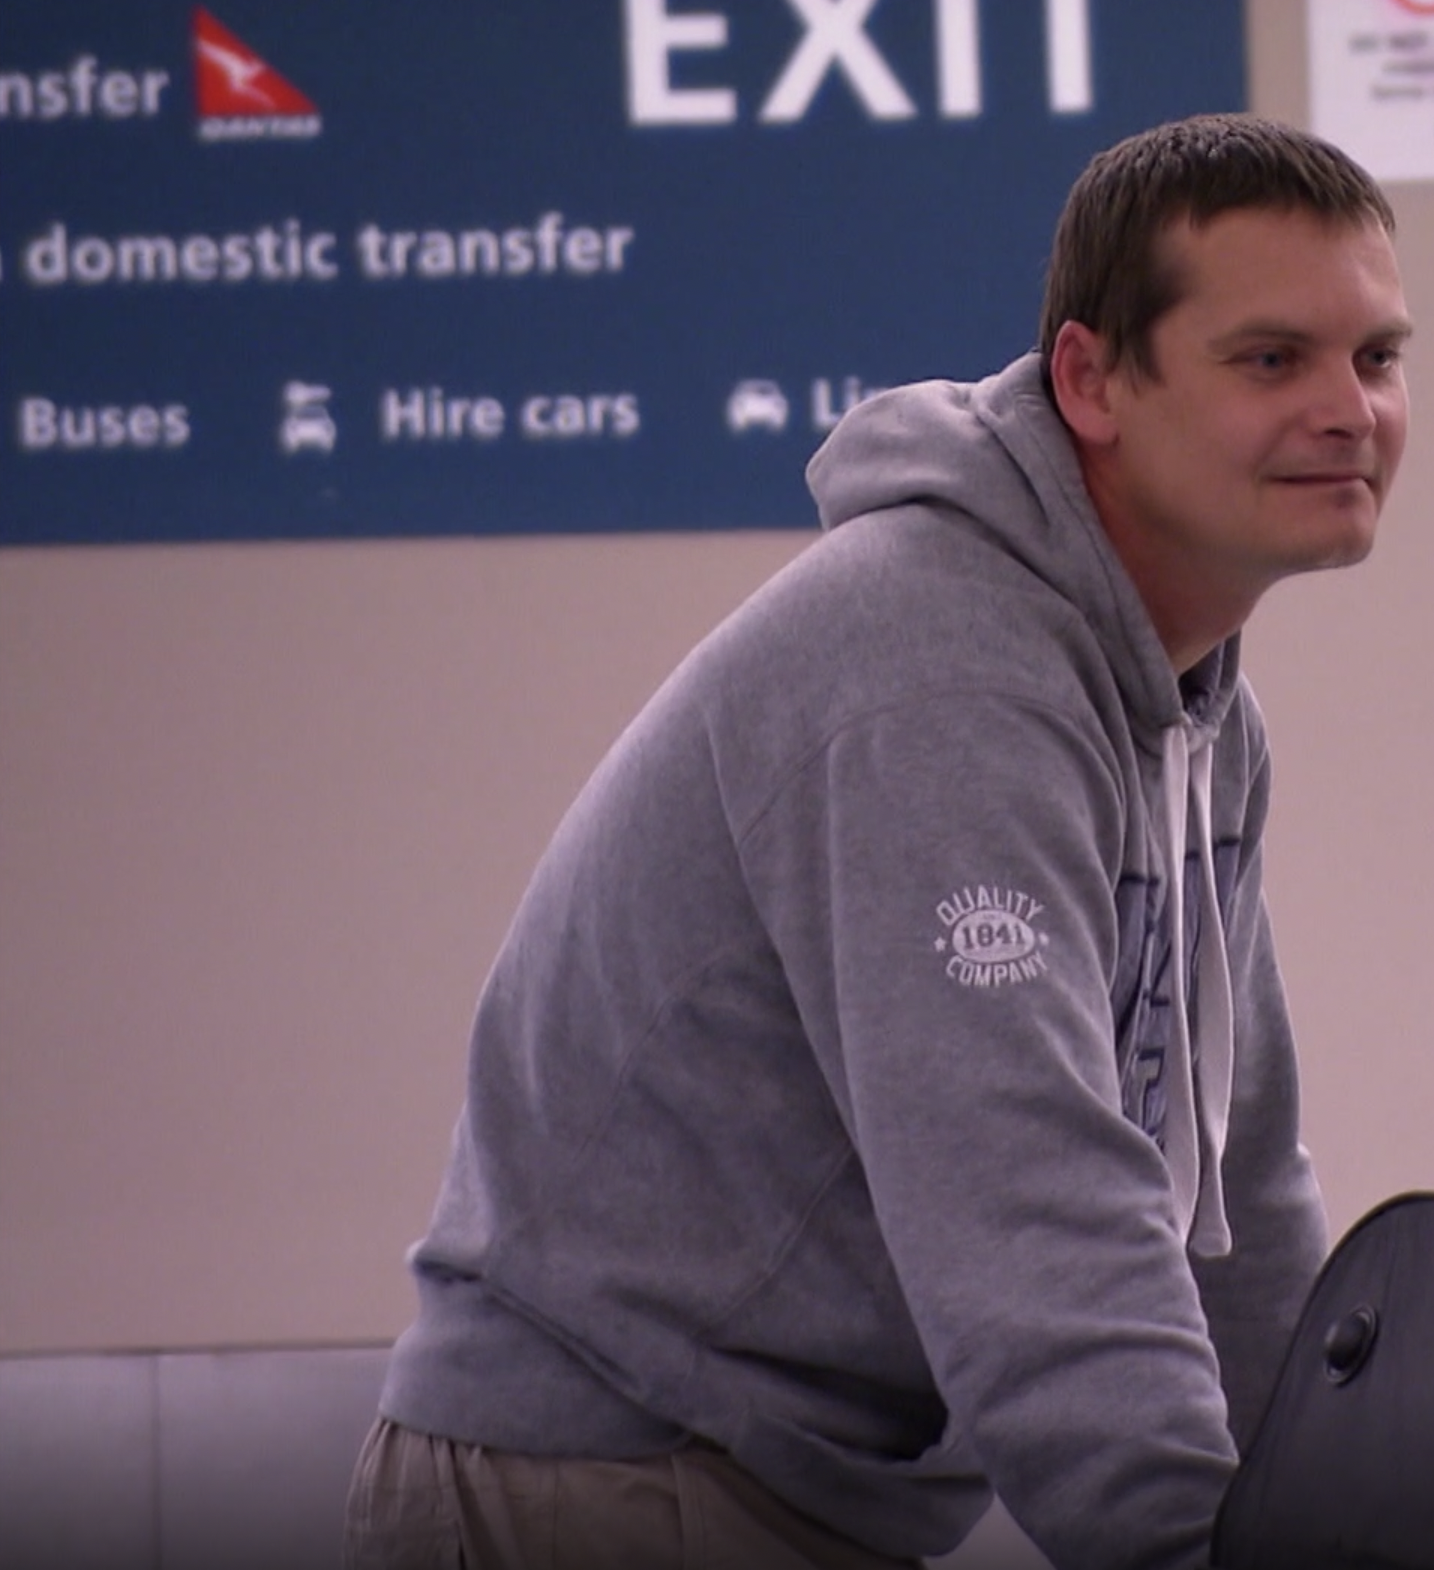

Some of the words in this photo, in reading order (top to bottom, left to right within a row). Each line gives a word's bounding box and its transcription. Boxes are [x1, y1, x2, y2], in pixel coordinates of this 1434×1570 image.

[26, 218, 338, 284] domestic
[357, 211, 634, 277] transfer
[20, 396, 191, 448] Buses
[381, 387, 503, 440] Hire
[521, 392, 640, 437] cars
[936, 884, 1045, 926] QUALITY
[961, 923, 1026, 950] 1841
[945, 950, 1048, 986] COMPANY
